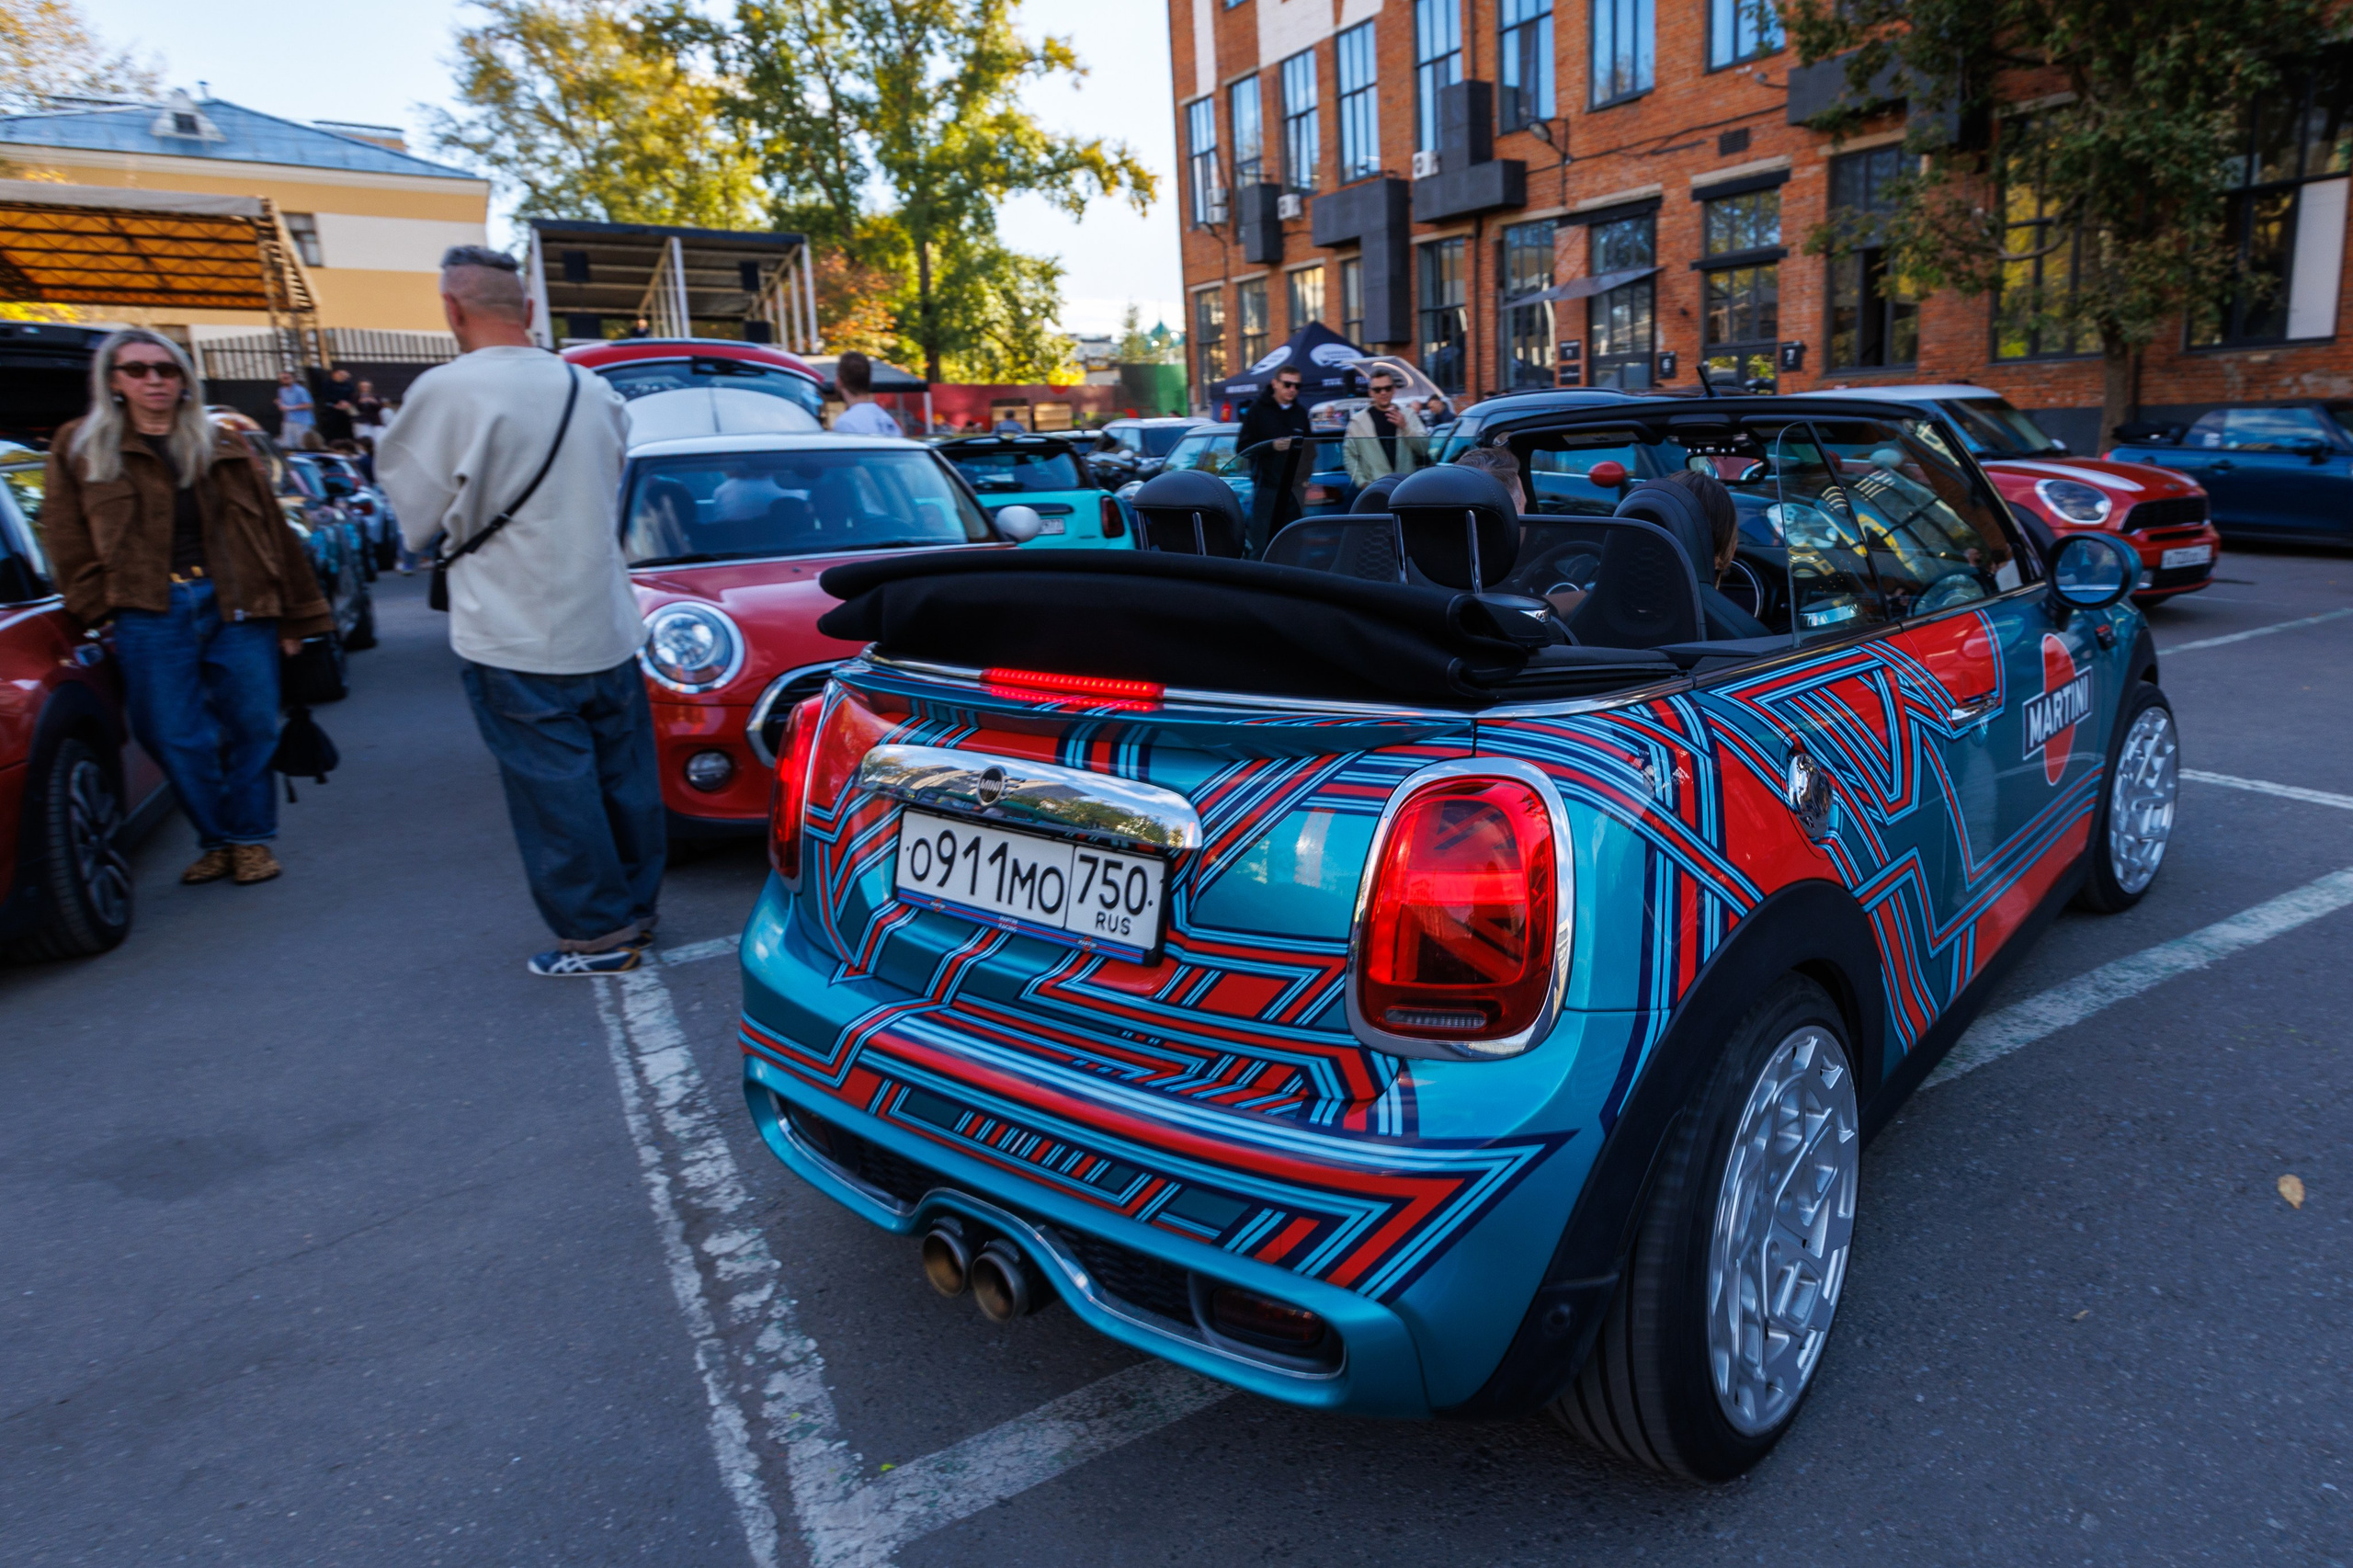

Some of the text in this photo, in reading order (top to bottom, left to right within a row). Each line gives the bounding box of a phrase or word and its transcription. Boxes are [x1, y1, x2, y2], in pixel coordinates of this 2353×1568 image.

[2029, 675, 2089, 748] MARTINI
[980, 778, 1002, 792] MINI
[910, 829, 1147, 915] О911МО 750
[1096, 911, 1131, 936] RUS
